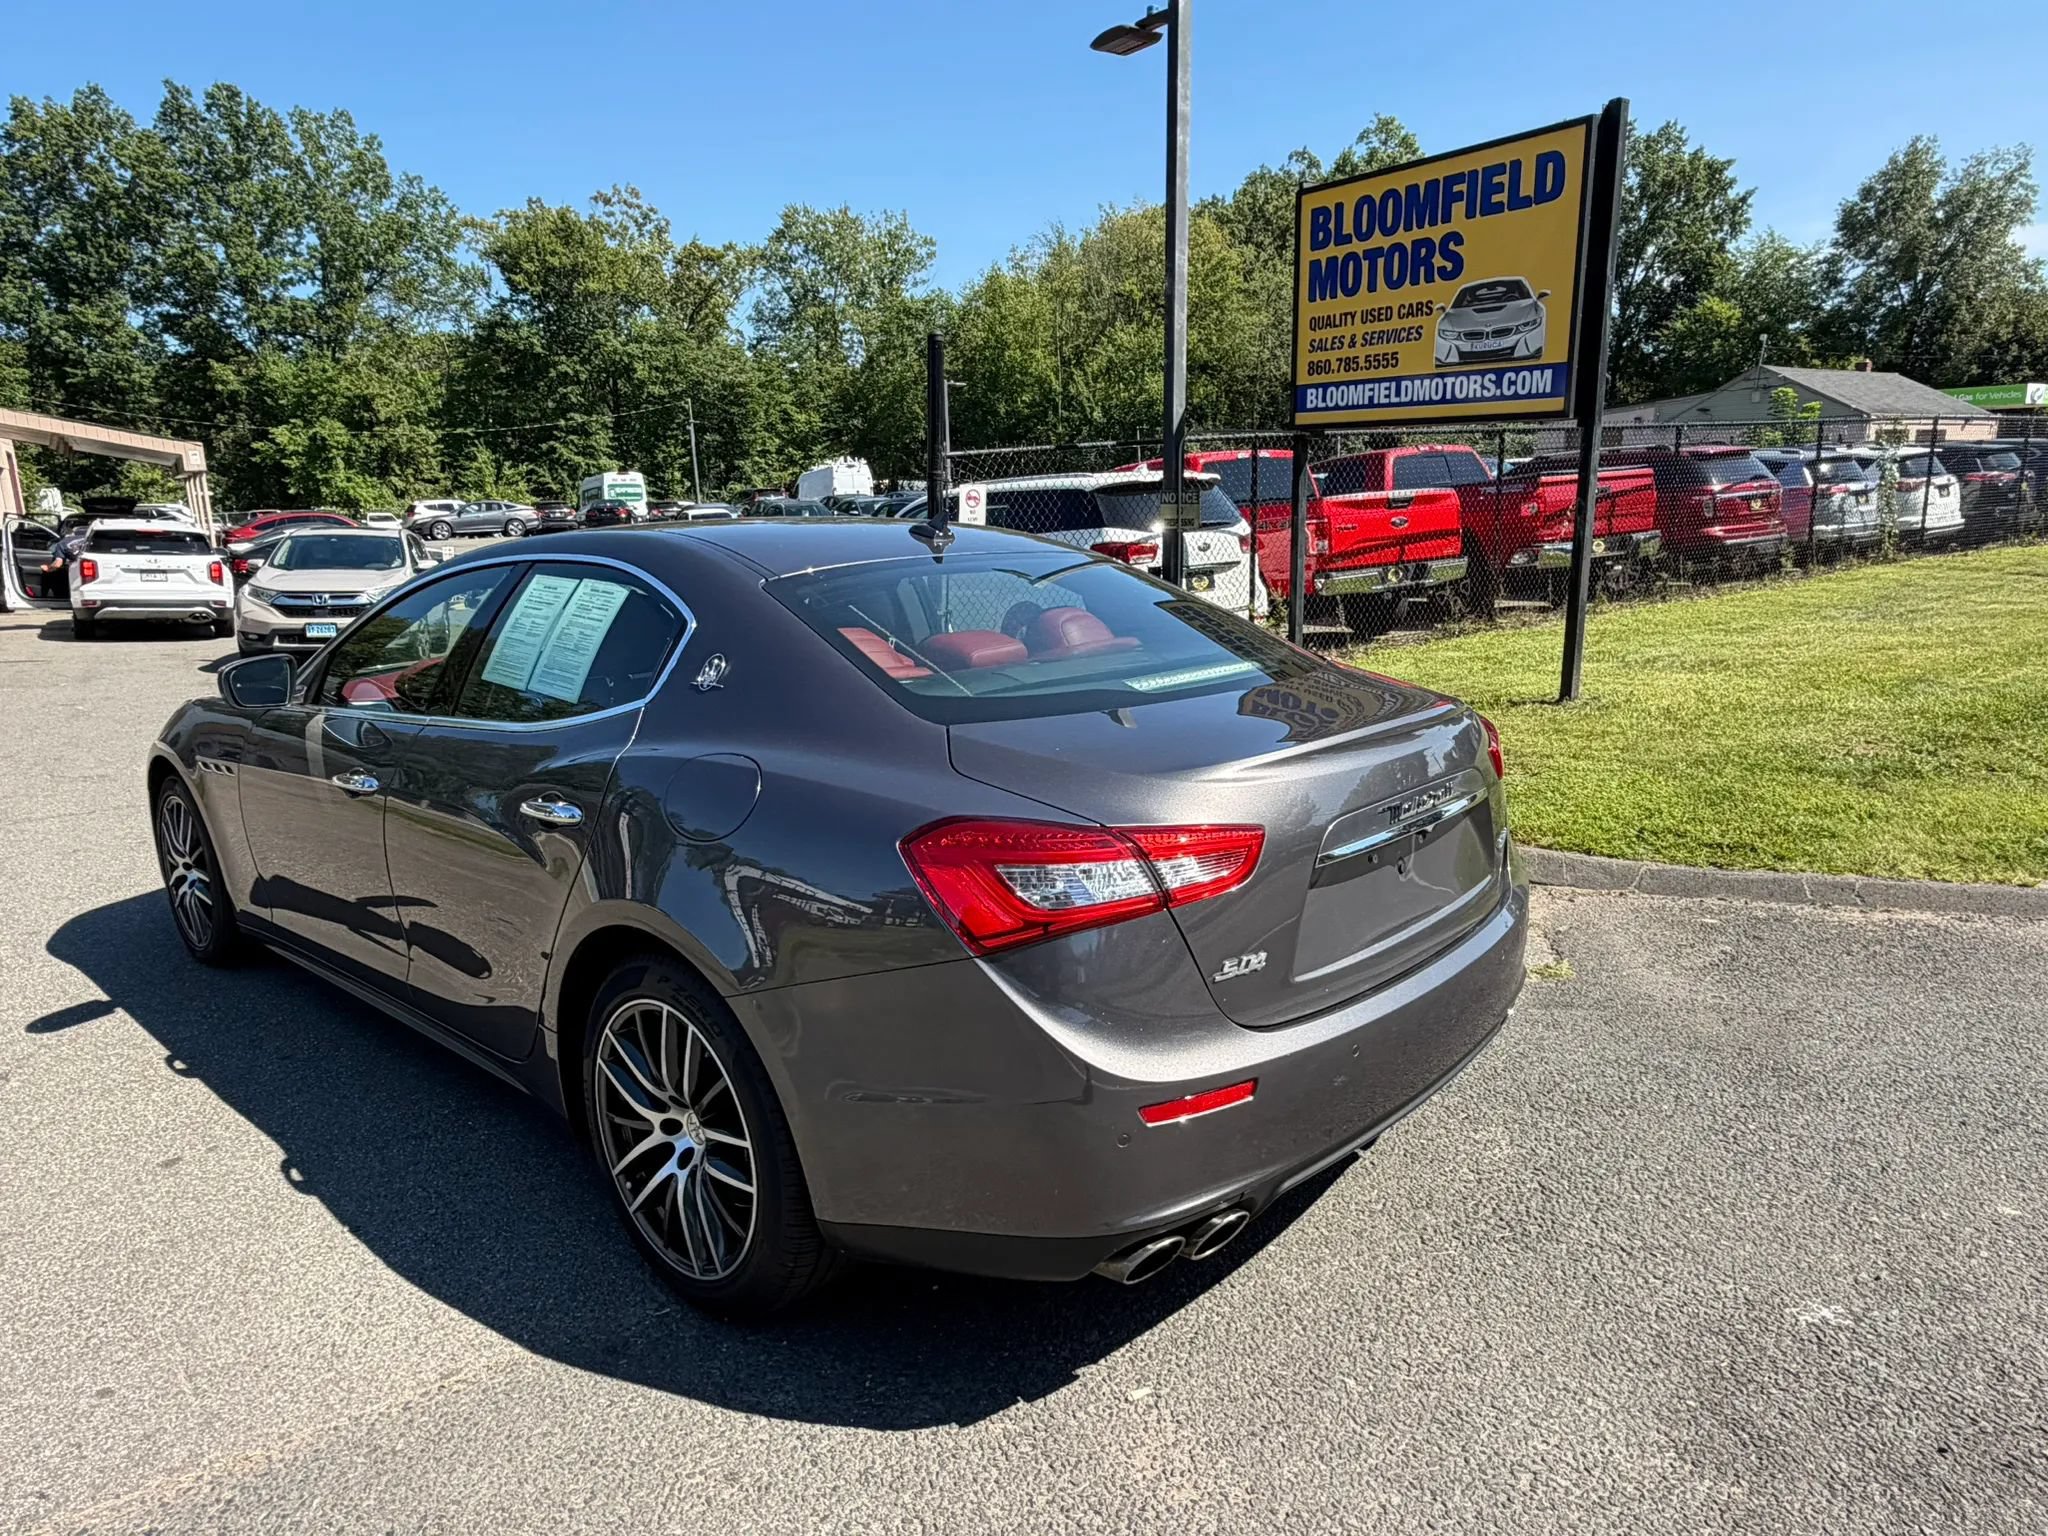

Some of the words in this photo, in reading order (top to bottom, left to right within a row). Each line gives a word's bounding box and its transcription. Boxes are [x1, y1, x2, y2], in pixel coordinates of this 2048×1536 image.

[1310, 150, 1566, 251] BLOOMFIELD
[1308, 231, 1465, 303] MOTORS
[1309, 310, 1358, 332] QUALITY
[1361, 305, 1393, 325] USED
[1397, 299, 1434, 320] CARS
[1308, 334, 1346, 354] SALES
[1348, 333, 1357, 349] &
[1360, 325, 1424, 348] SERVICES
[1307, 351, 1399, 377] 860.785.5555
[1306, 368, 1553, 409] BLOOMFIELDMOTORS.COM
[1975, 392, 1987, 400] for
[1989, 390, 2022, 400] Vehicles
[1161, 492, 1199, 504] NOICE
